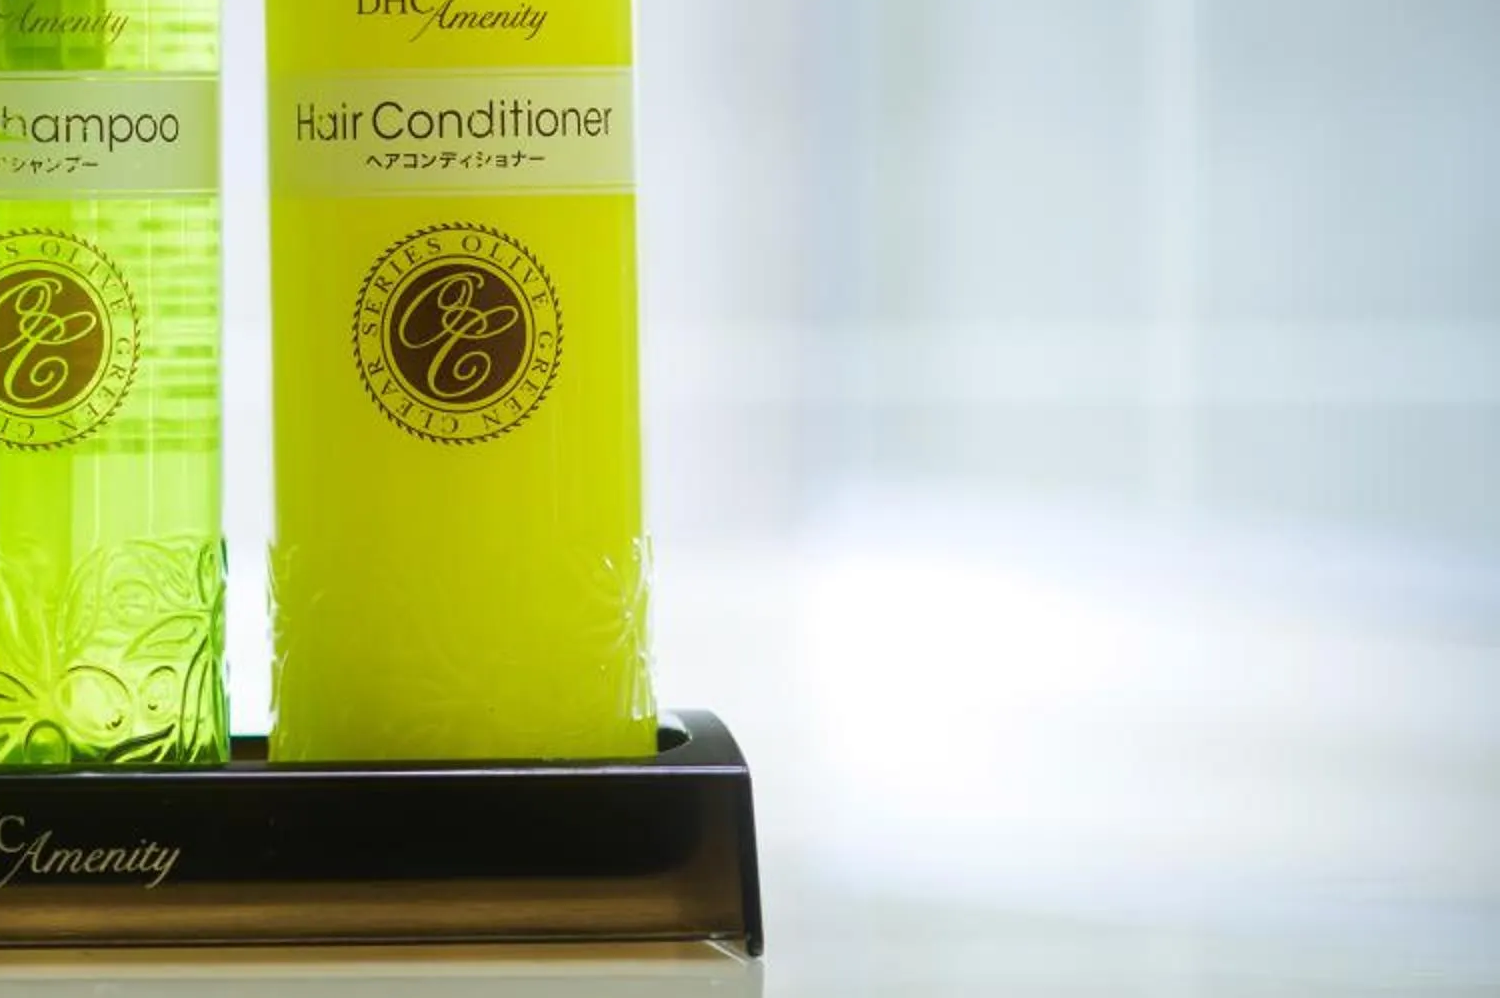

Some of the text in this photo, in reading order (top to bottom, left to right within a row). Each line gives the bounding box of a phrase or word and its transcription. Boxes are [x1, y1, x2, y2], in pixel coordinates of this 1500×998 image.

[296, 99, 612, 141] Hair Conditioner
[365, 149, 546, 170] ヘアコンディショナー
[362, 234, 554, 435] OLIVE GREEN CLEAR SERIES
